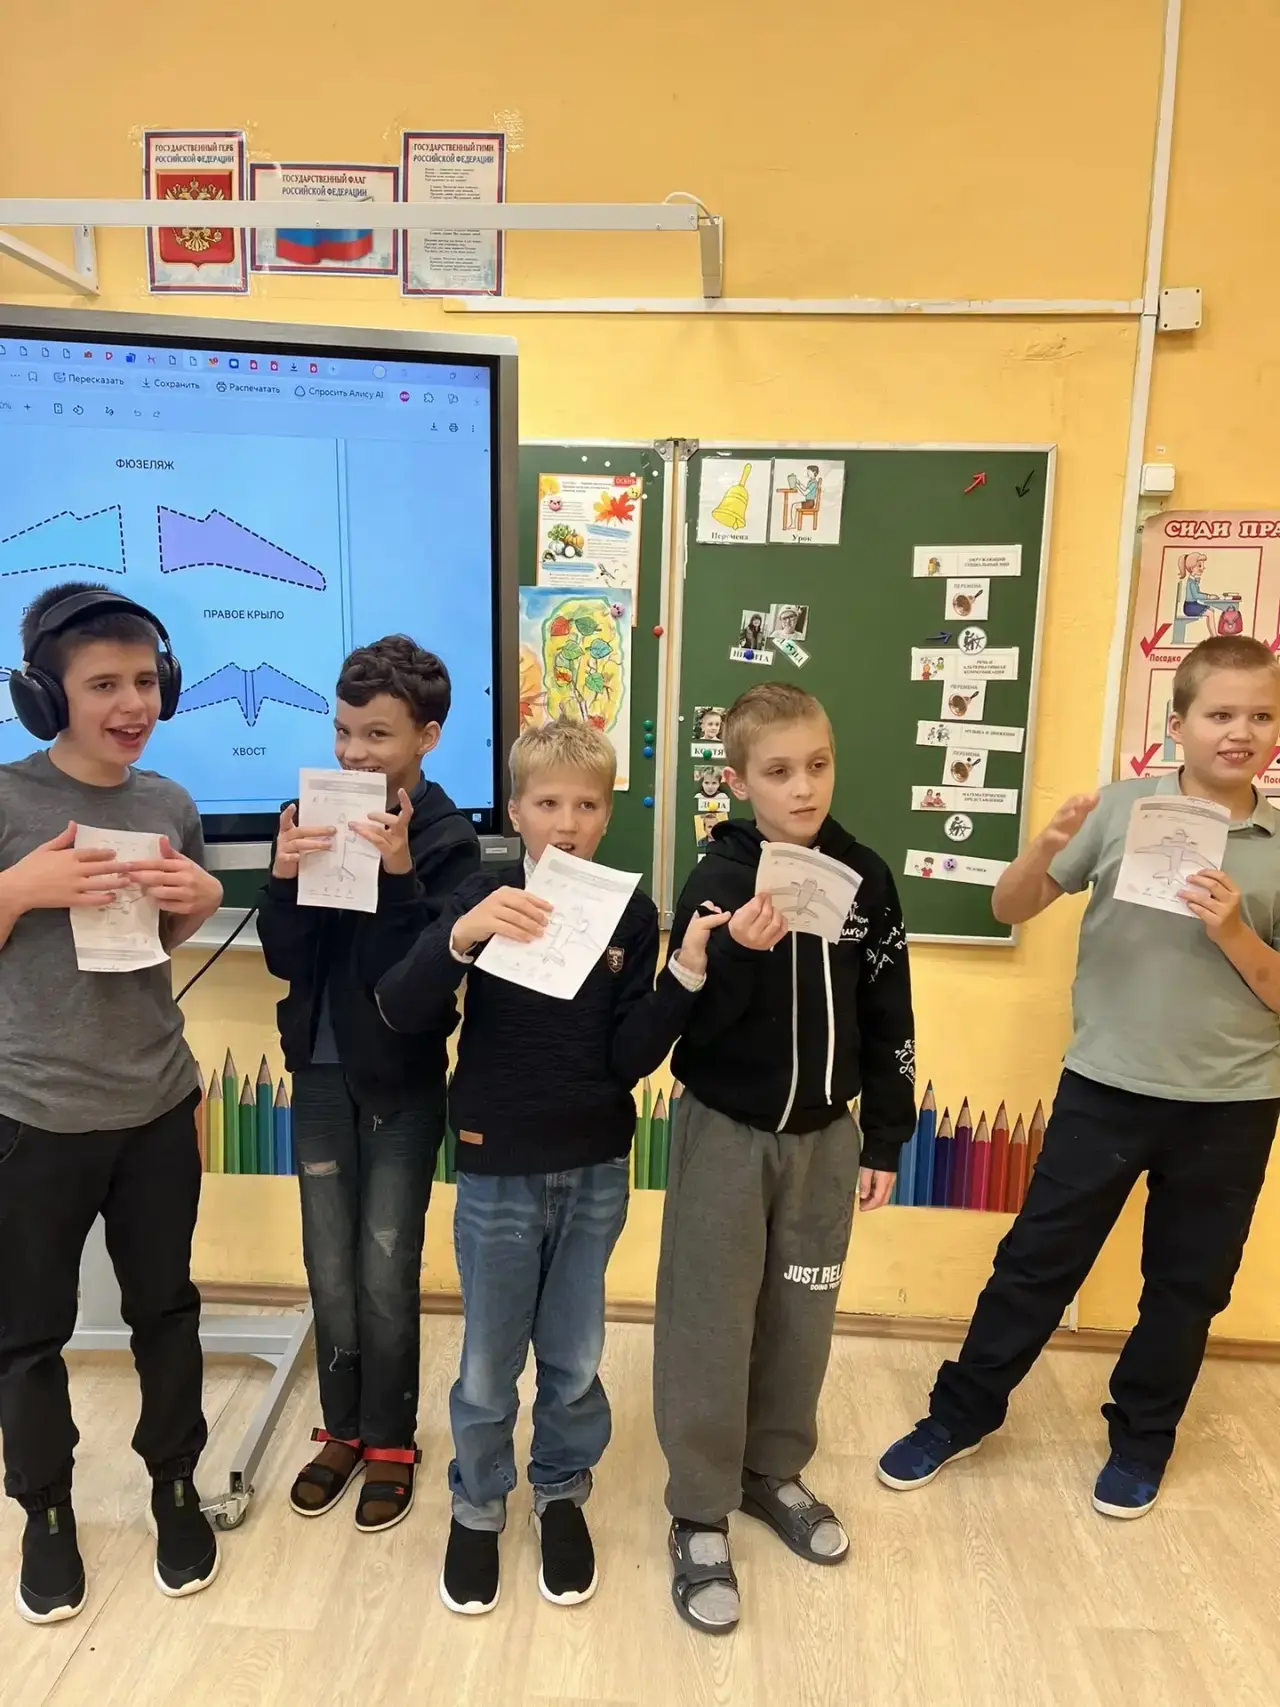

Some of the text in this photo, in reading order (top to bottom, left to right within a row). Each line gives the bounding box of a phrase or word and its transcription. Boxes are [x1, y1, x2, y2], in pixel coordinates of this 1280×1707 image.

[155, 142, 234, 153] ГОСУДАРСТВЕННЫЙ ГЕРБ
[414, 142, 494, 152] ГОСУДАРСТВЕННЫЙ ГИМН
[155, 153, 234, 164] РОССИЙСКОЙ ФЕДЕРАЦИИ
[413, 153, 494, 164] РОССИЙСКОЙ ФЕДЕРАЦИИ
[282, 173, 366, 184] ГОСУДАРСТВЕННЫЙ ФЛАГ
[282, 185, 367, 197] РОССИЙСКОЙ ФЕДЕРАЦИИ
[68, 374, 124, 386] Пересказать
[154, 378, 200, 390] Сохранить
[229, 383, 281, 394] Распечатать
[308, 387, 348, 398] Спросить
[349, 389, 373, 400] Алису
[115, 458, 175, 470] ФЮЗЕЛЯЖ
[1165, 520, 1232, 540] СИДИ
[711, 532, 749, 542] Перемена
[792, 534, 812, 543] Урок
[203, 609, 285, 620] ПРАВОЕ КРЫЛО
[1149, 653, 1181, 663] Посадка
[232, 746, 267, 756] ХВОСТ
[783, 1265, 820, 1284] JUST
